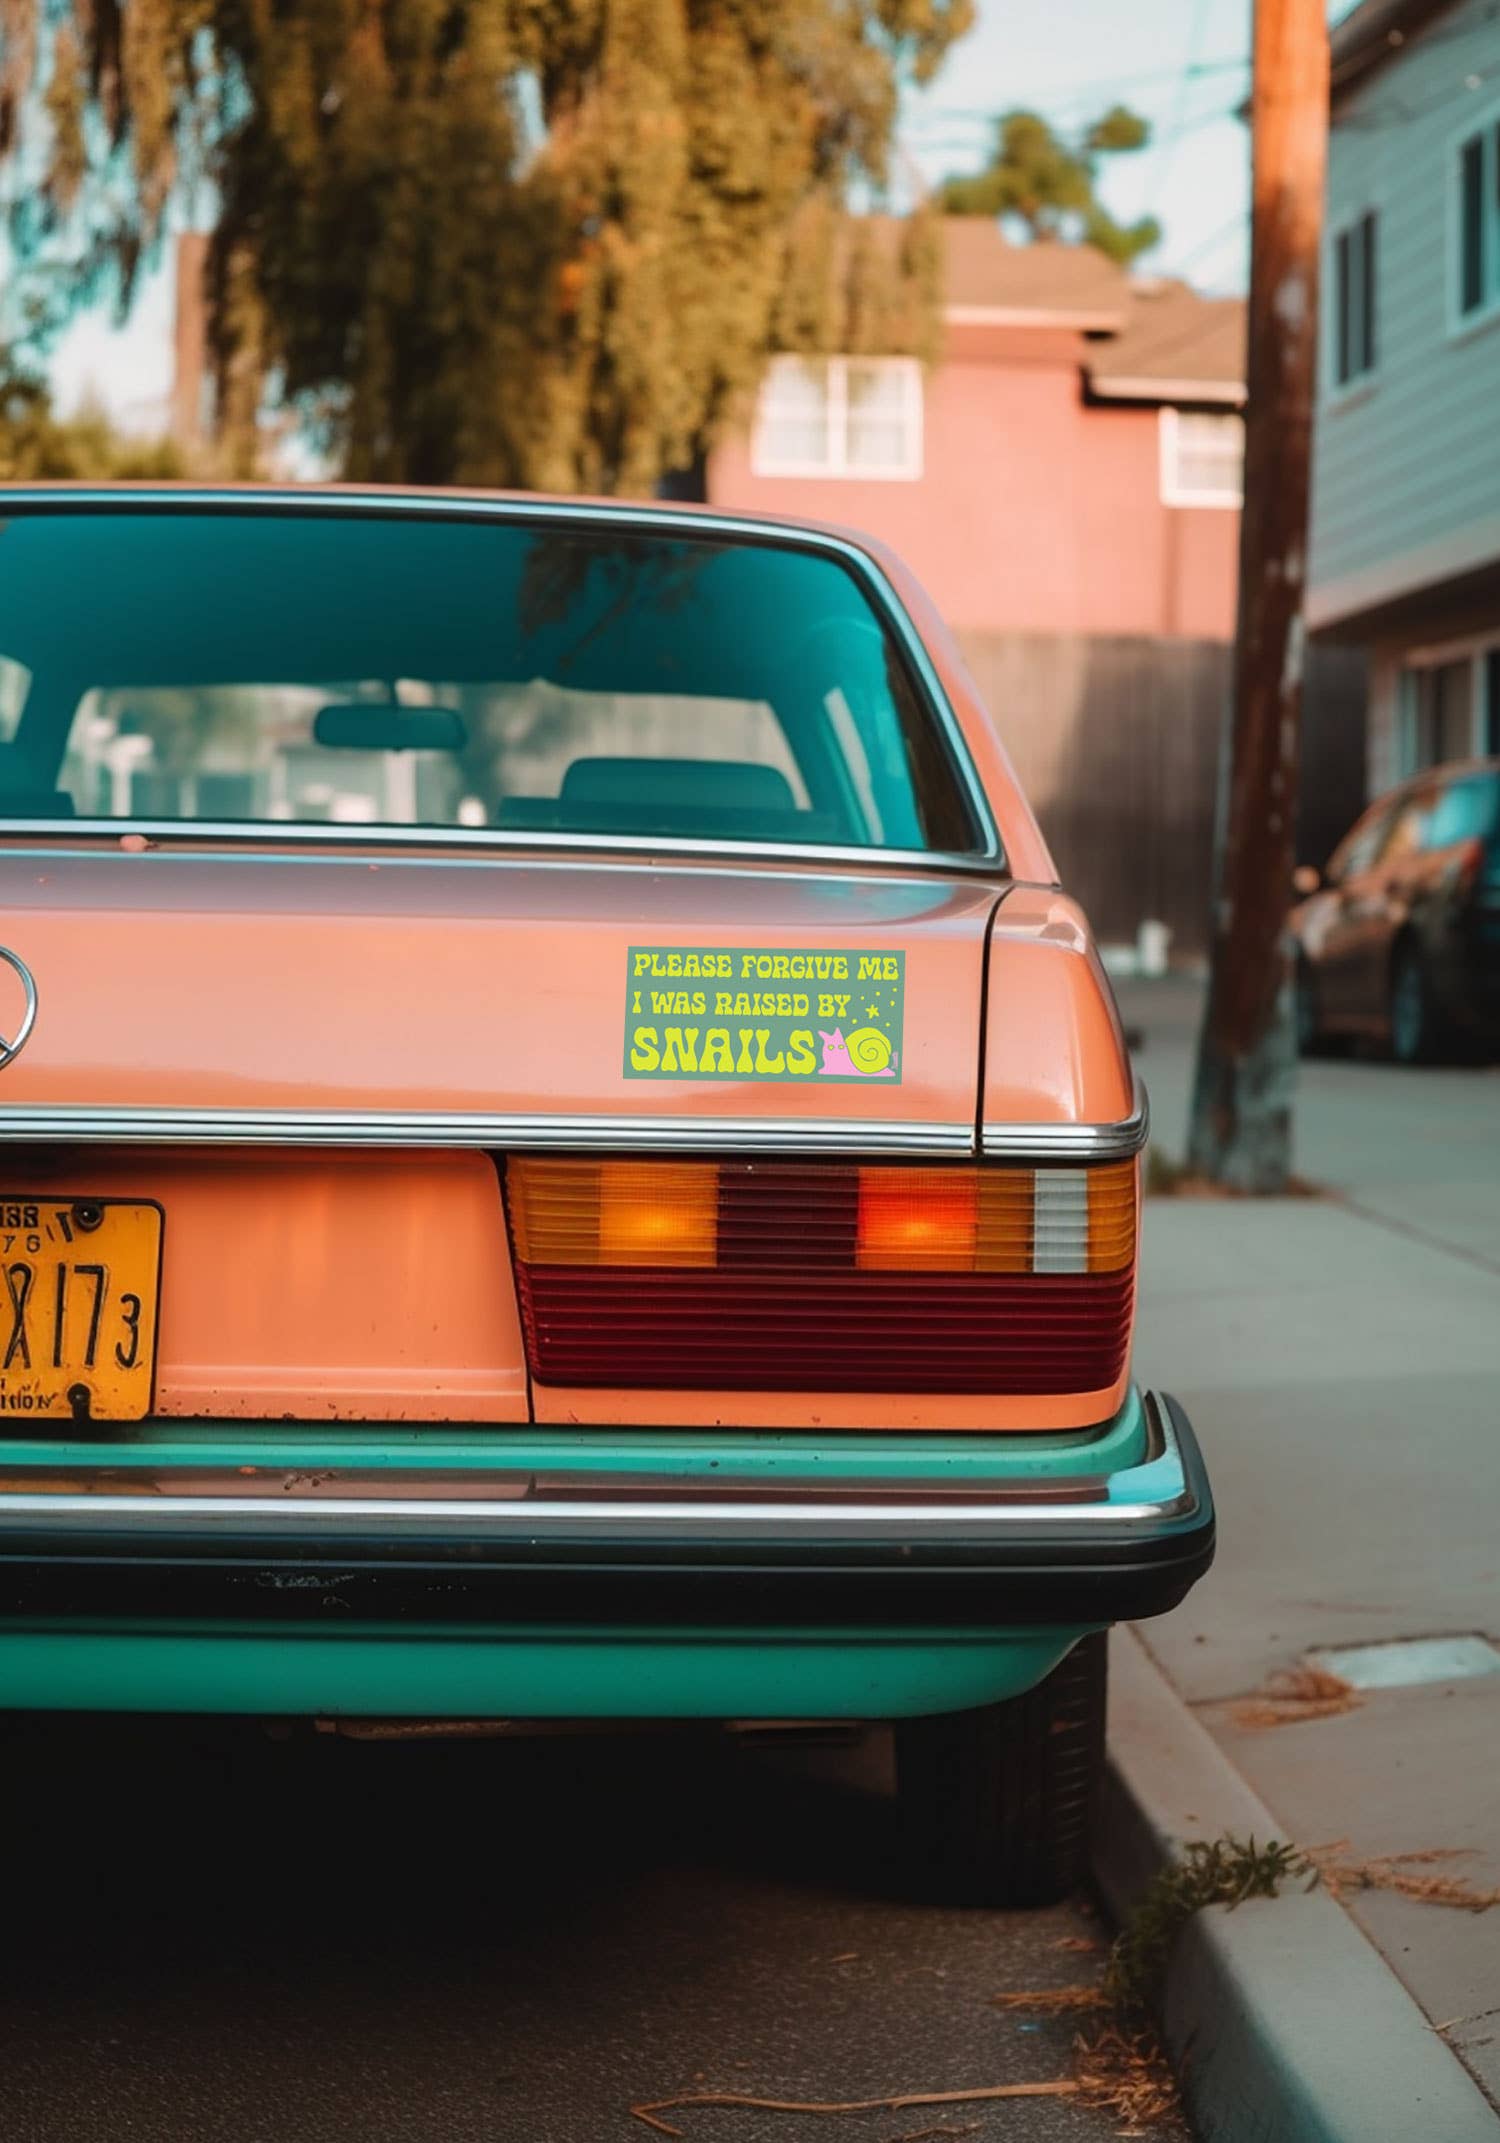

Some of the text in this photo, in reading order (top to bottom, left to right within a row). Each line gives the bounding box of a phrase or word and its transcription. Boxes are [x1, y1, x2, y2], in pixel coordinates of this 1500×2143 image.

[633, 953, 899, 981] PLEASE FORGIVE ME
[632, 991, 851, 1017] I WAS RAISED BY
[630, 1026, 817, 1075] SNAILS
